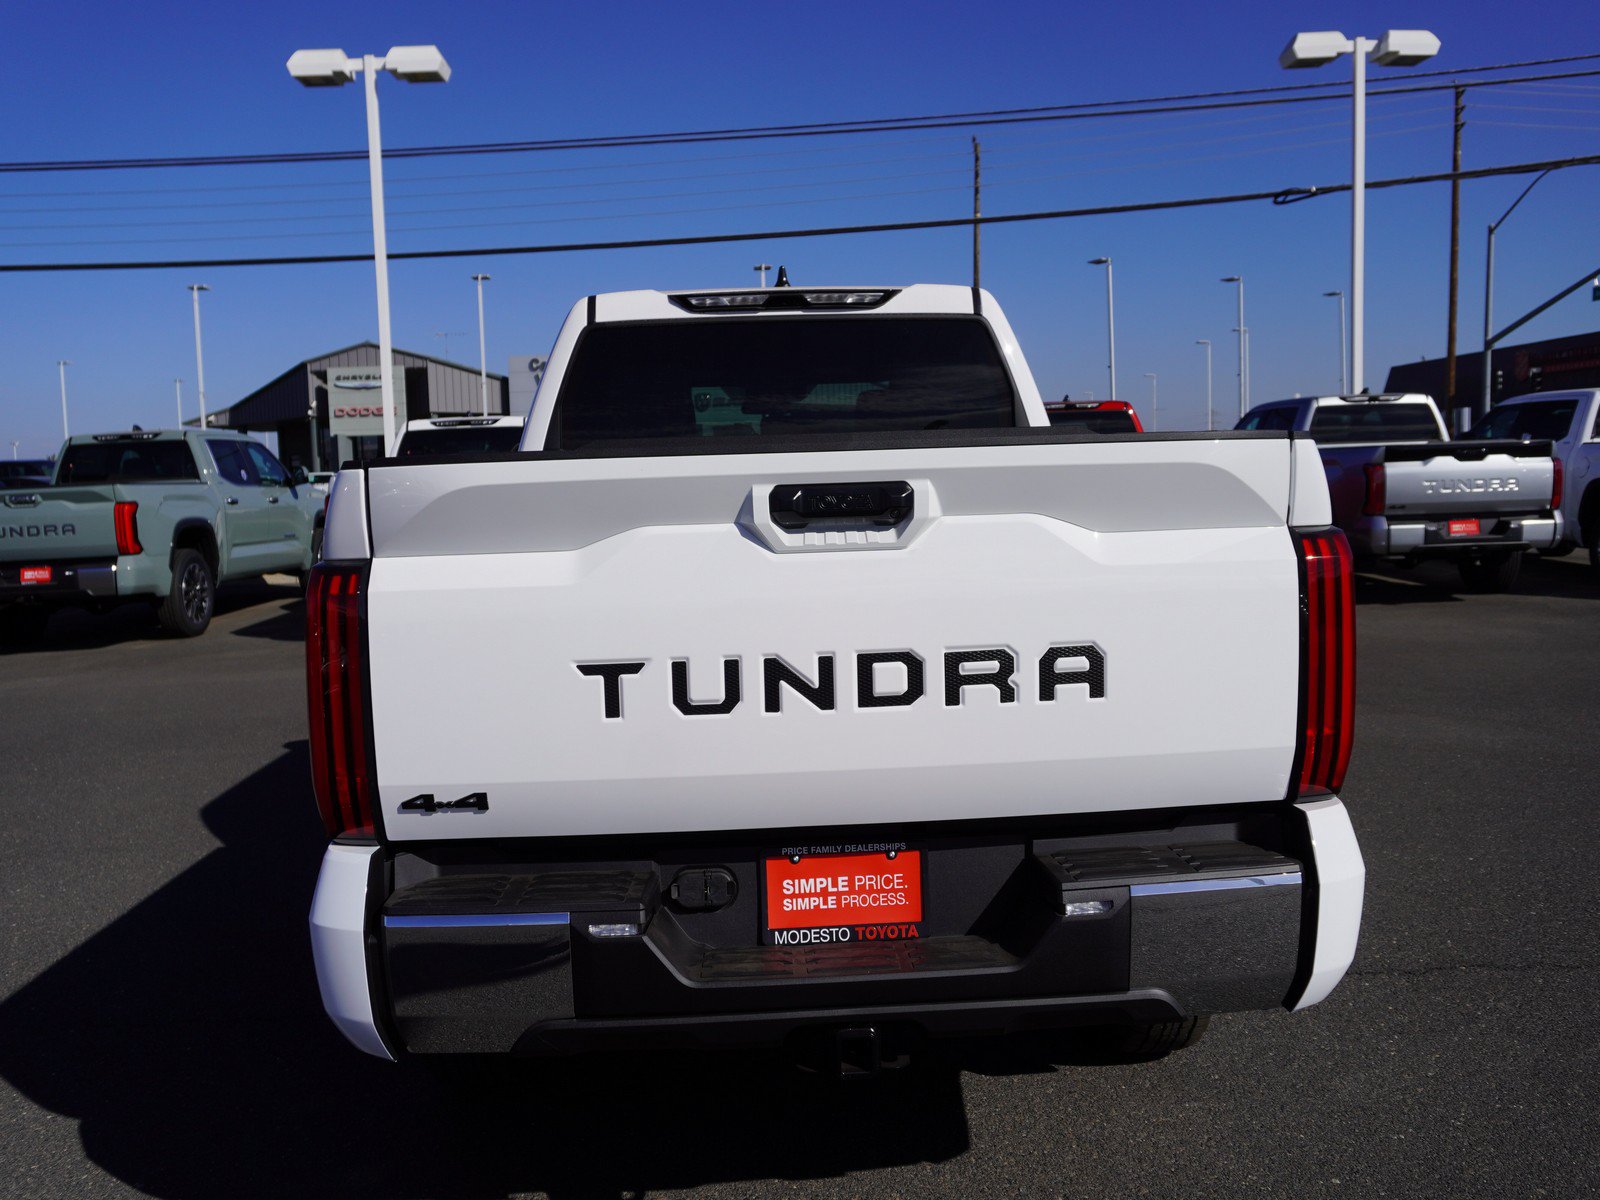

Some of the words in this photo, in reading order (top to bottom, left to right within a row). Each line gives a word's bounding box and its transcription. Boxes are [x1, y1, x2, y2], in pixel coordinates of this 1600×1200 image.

[334, 406, 397, 418] DODG
[1422, 478, 1520, 493] TUNDRA
[574, 642, 1106, 719] TUNDRA
[782, 846, 808, 855] PRICE
[811, 845, 842, 854] FAMILY
[844, 842, 906, 853] DEALERSHIPS
[782, 876, 849, 895] SIMPLE
[854, 873, 908, 891] PRICE.
[783, 896, 837, 911] SIMPLE
[841, 892, 909, 908] PROCESS.
[774, 927, 850, 945] MODESTO
[855, 924, 919, 941] TOYOTA
